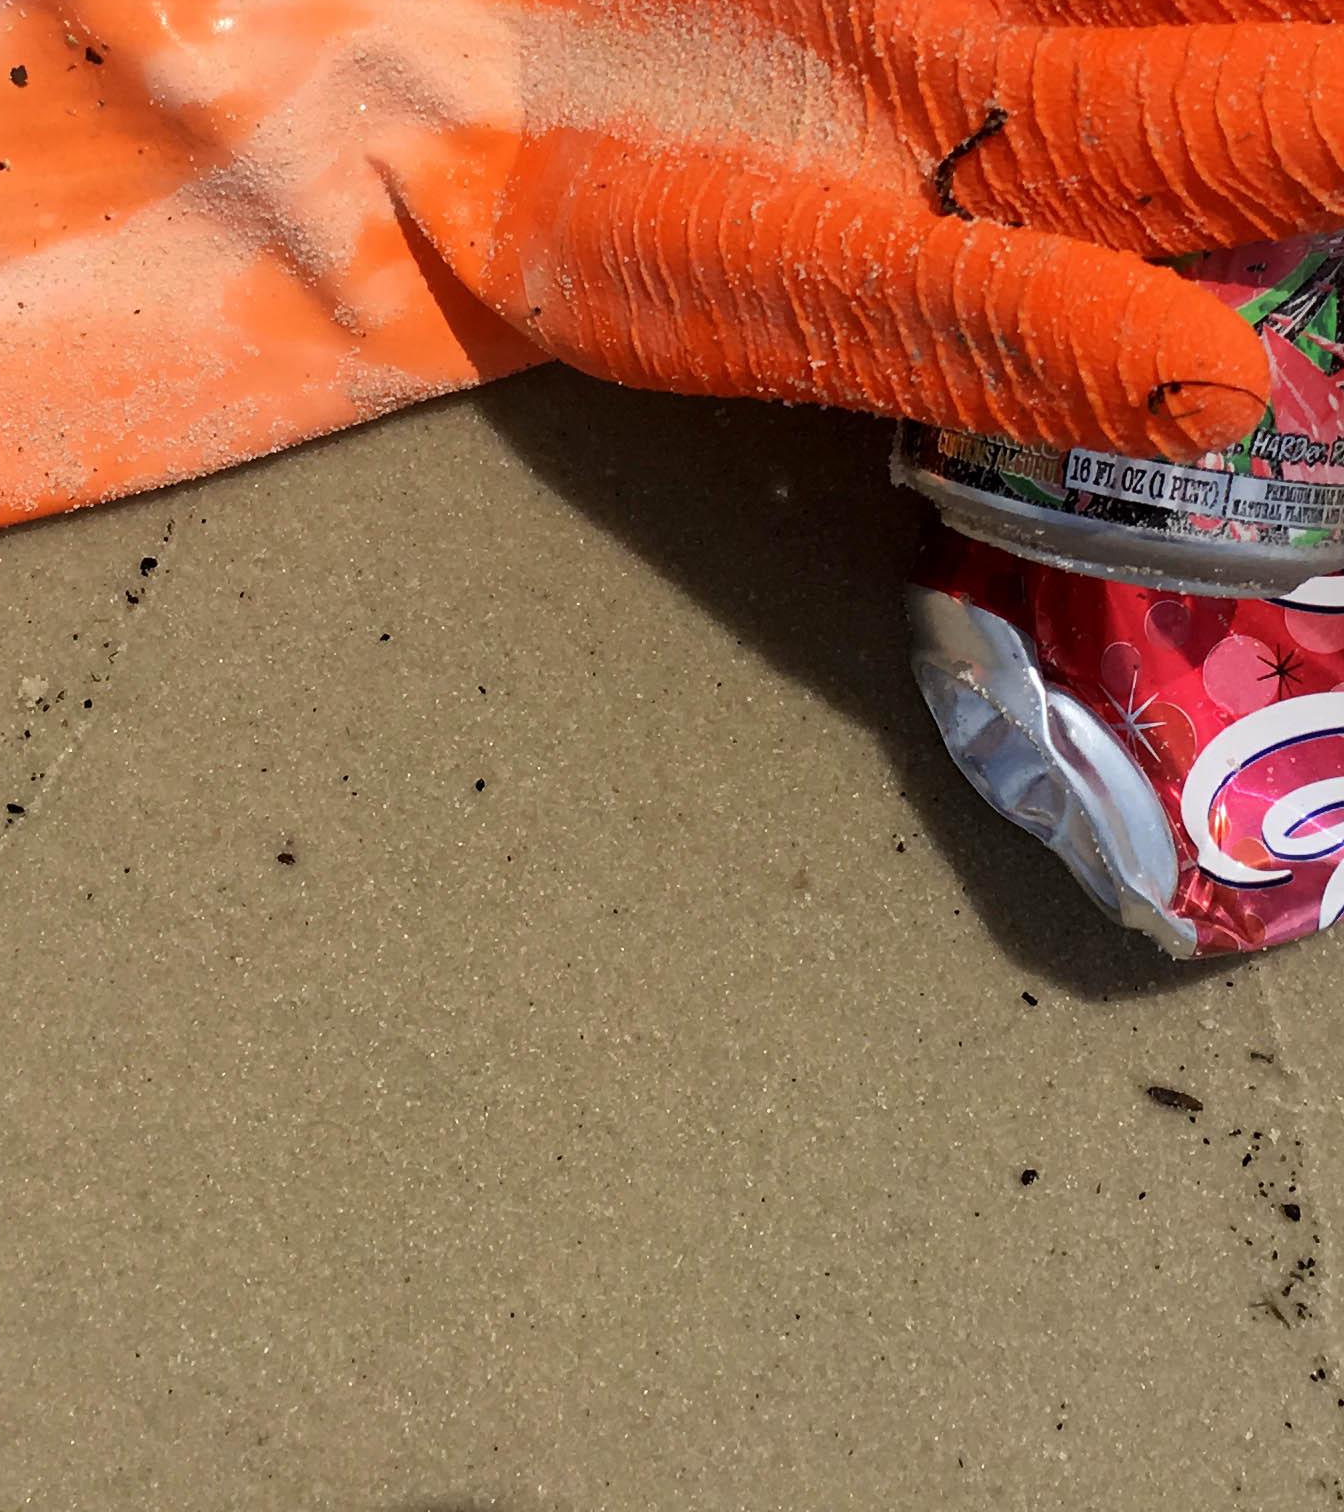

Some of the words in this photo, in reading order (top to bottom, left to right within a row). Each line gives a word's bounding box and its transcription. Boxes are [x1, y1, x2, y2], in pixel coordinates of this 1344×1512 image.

[1069, 454, 1092, 484] 16
[1093, 459, 1116, 488] FL
[1121, 466, 1148, 495] OZ
[1149, 469, 1167, 500] (1
[1168, 474, 1220, 510] PINT)
[1231, 498, 1282, 522] NATURAL
